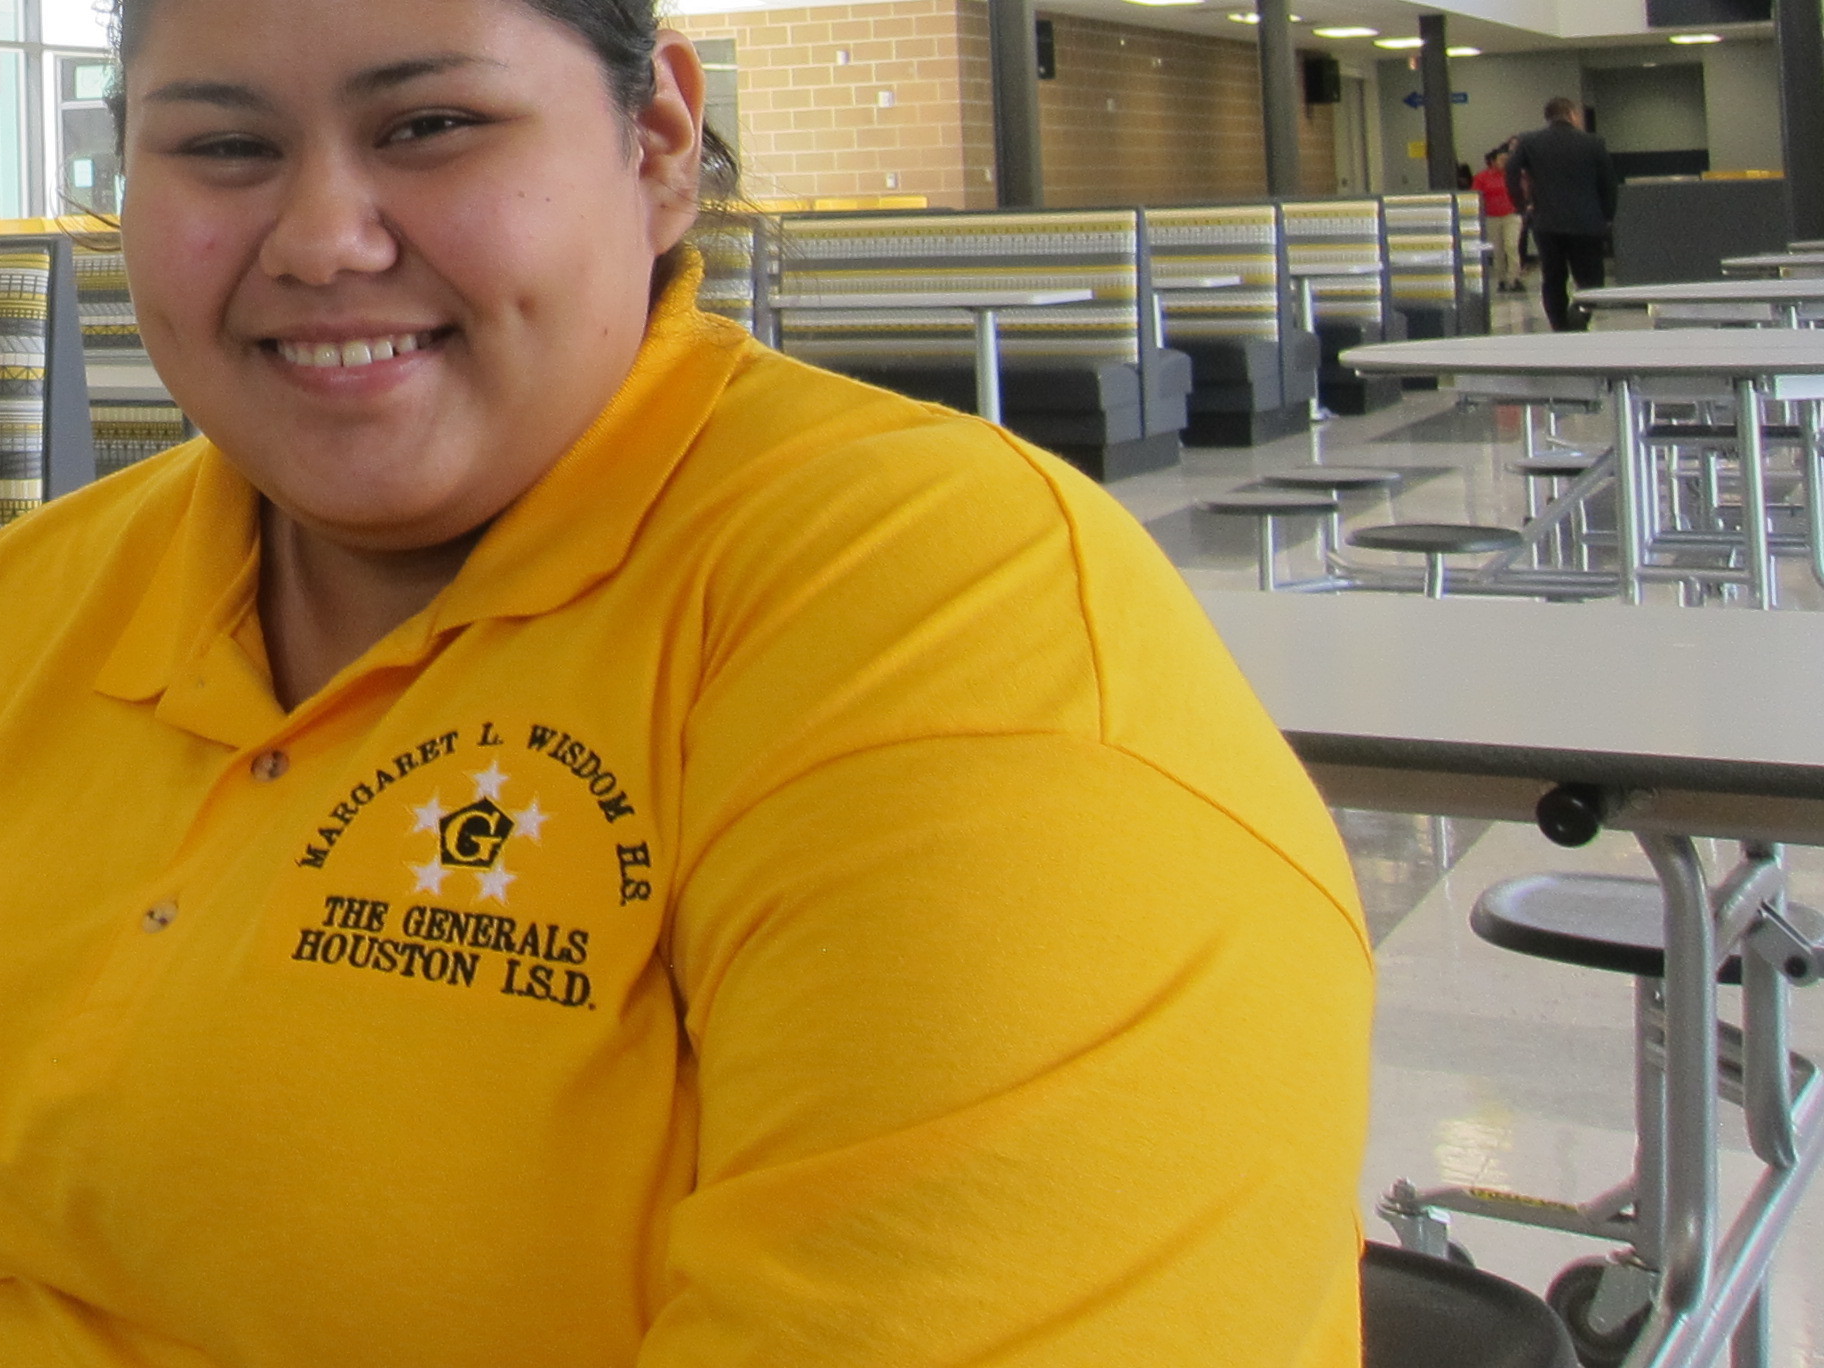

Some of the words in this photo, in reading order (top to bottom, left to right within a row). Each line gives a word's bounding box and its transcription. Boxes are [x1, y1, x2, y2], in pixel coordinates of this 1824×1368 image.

[295, 730, 459, 870] MARGARET
[526, 723, 636, 824] WISDOM
[290, 929, 482, 988] HOUSTON
[320, 895, 390, 933] THE
[402, 903, 590, 966] GENERALS
